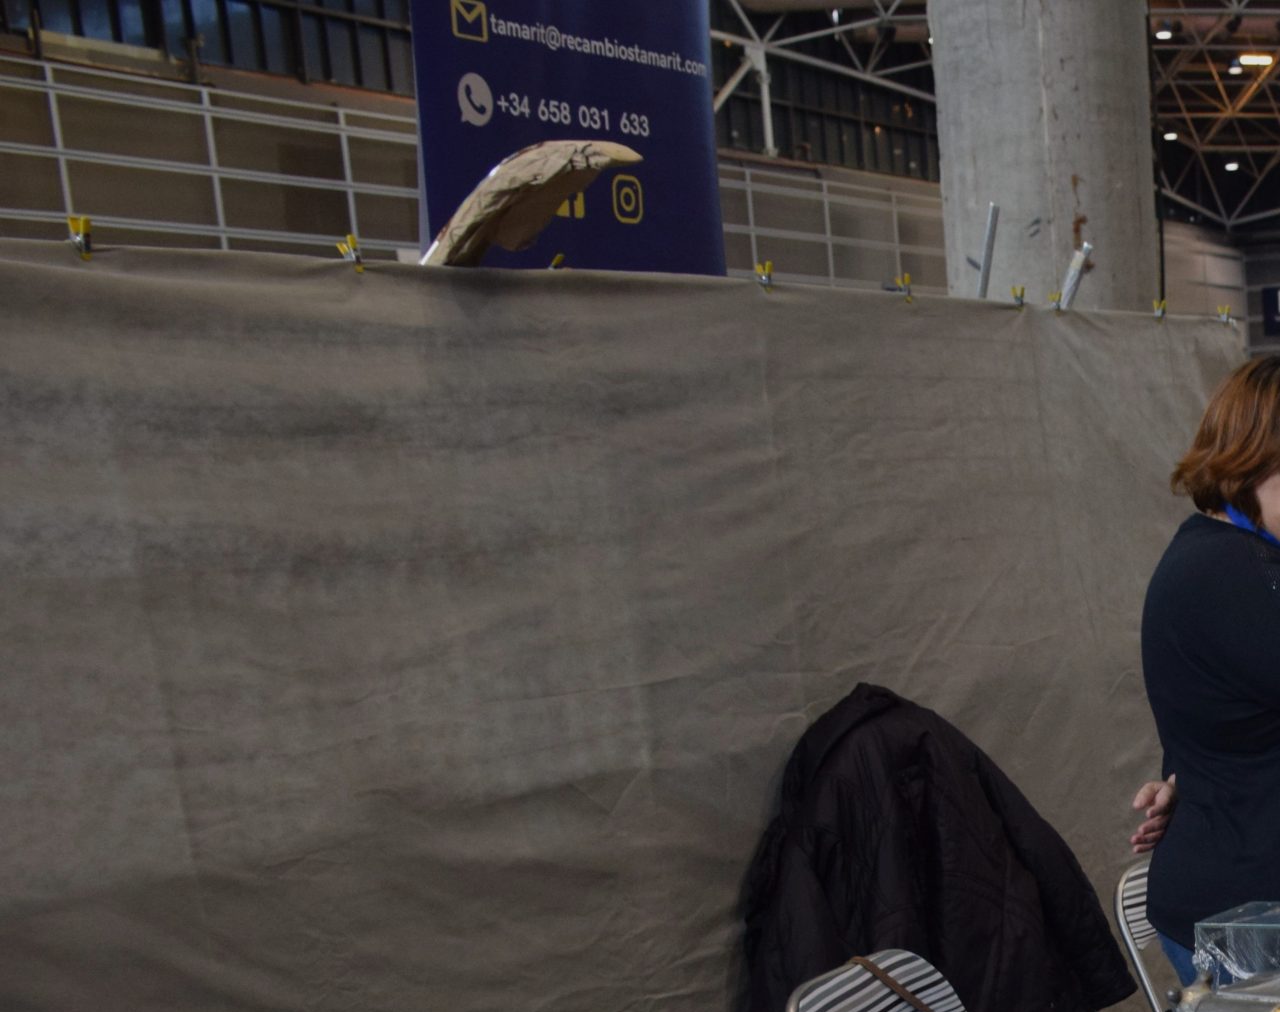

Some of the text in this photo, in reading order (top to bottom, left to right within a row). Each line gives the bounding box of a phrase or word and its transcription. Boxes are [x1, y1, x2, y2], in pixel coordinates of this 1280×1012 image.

[490, 14, 707, 78] tamarit@recambiostamarit.com
[497, 93, 650, 138] +34 658 031 633
